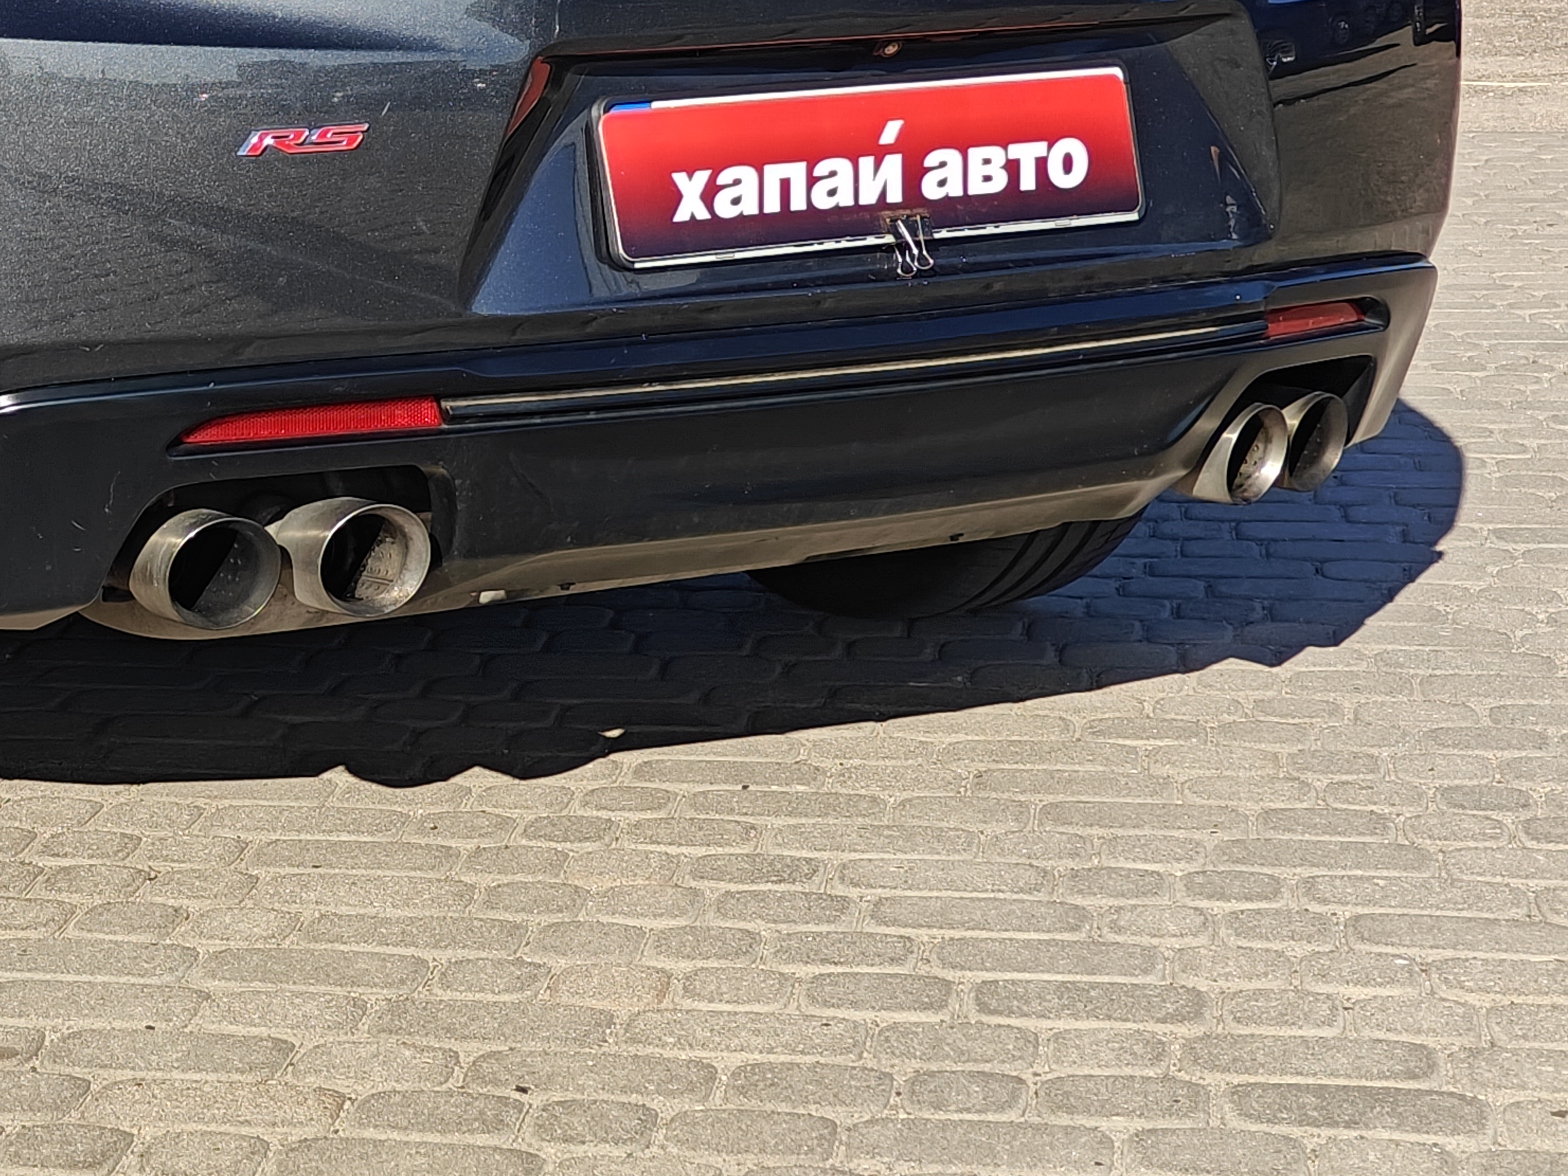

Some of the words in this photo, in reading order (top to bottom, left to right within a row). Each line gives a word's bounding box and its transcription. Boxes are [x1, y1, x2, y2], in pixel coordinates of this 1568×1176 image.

[236, 122, 370, 157] RS
[671, 120, 905, 224] хапай
[920, 136, 1089, 201] авто
